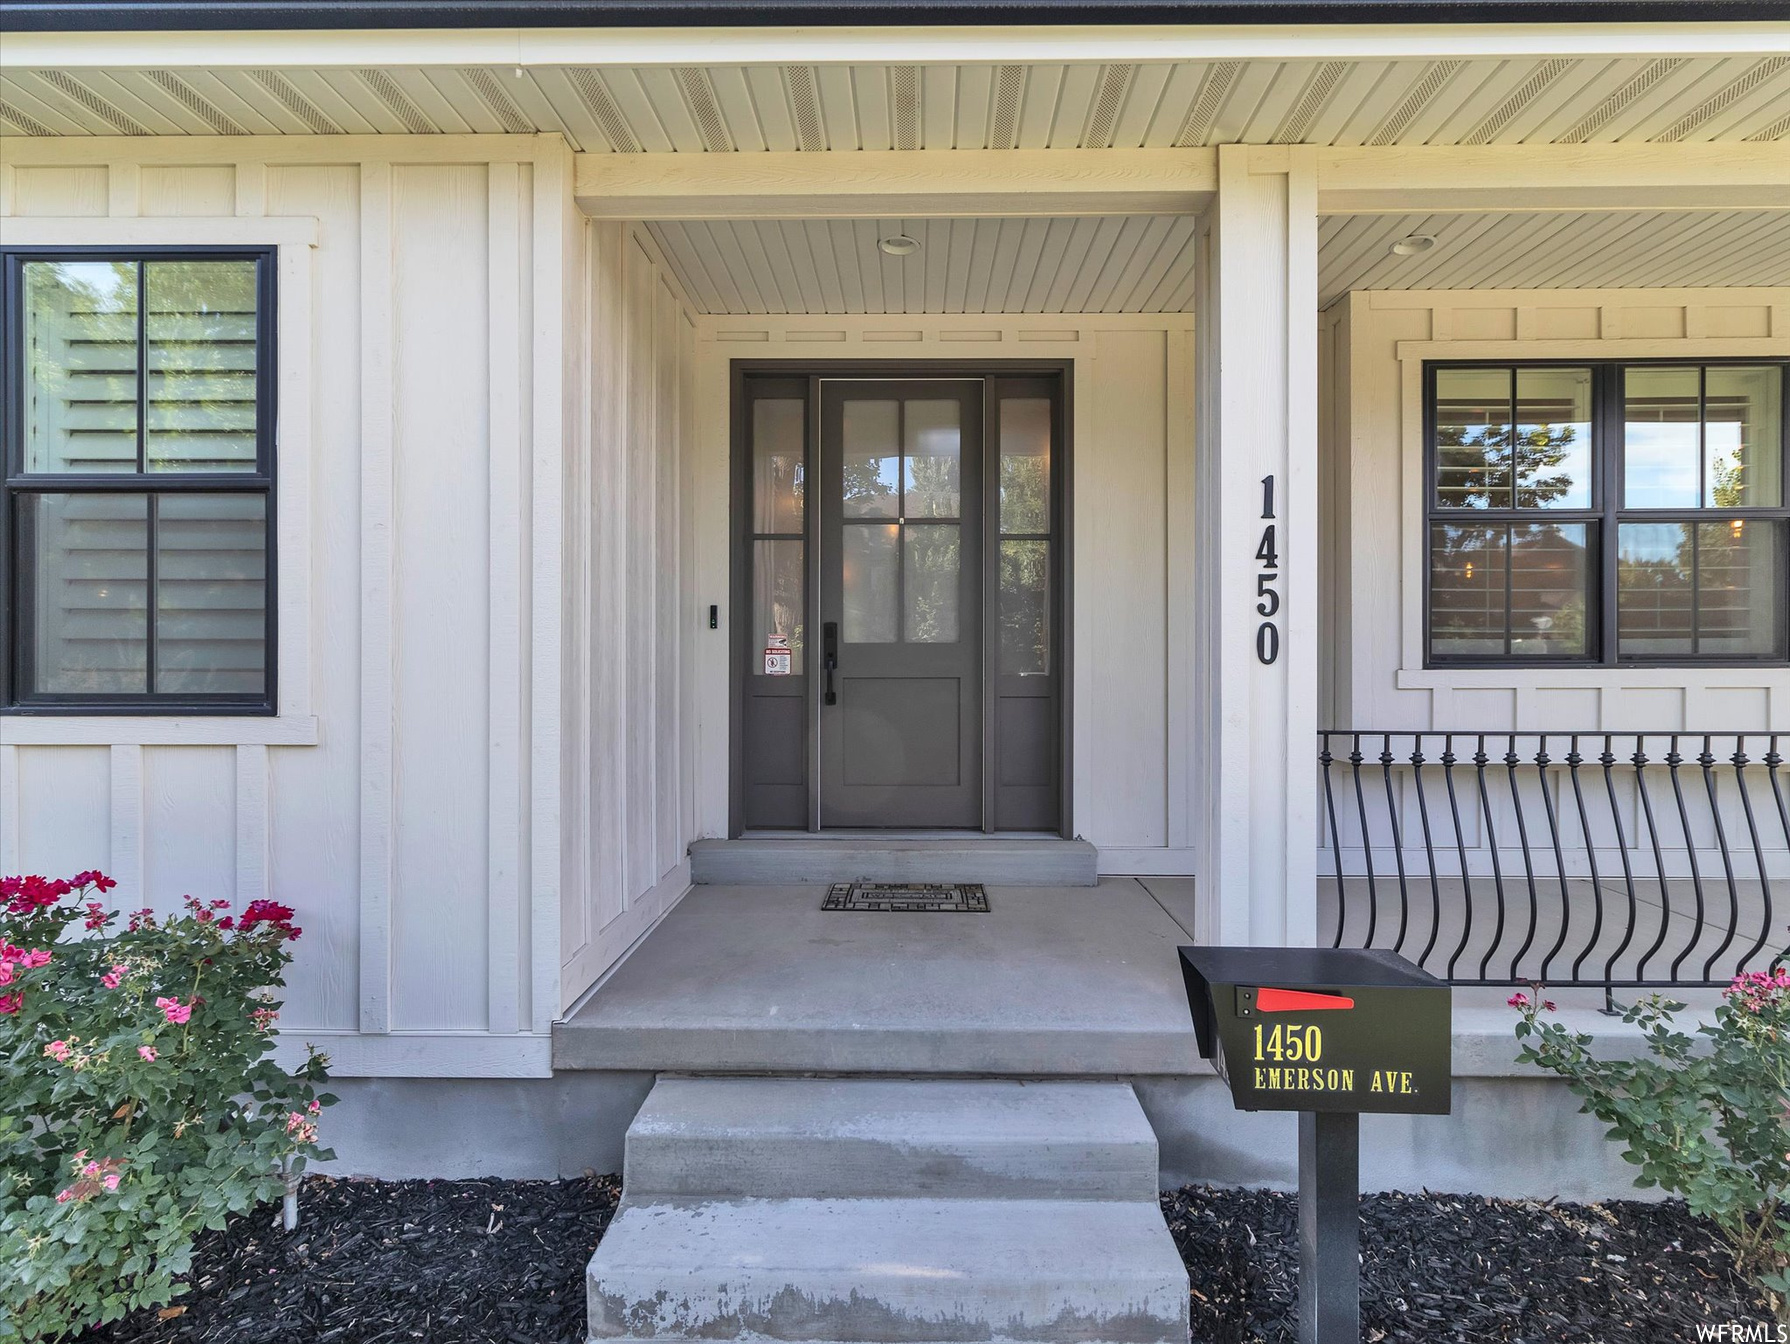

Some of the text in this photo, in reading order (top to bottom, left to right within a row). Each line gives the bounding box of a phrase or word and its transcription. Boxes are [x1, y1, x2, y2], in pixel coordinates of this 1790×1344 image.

[1255, 474, 1280, 665] 1450
[1254, 1024, 1322, 1062] 1450
[1254, 1067, 1419, 1094] EMERSON AVE.
